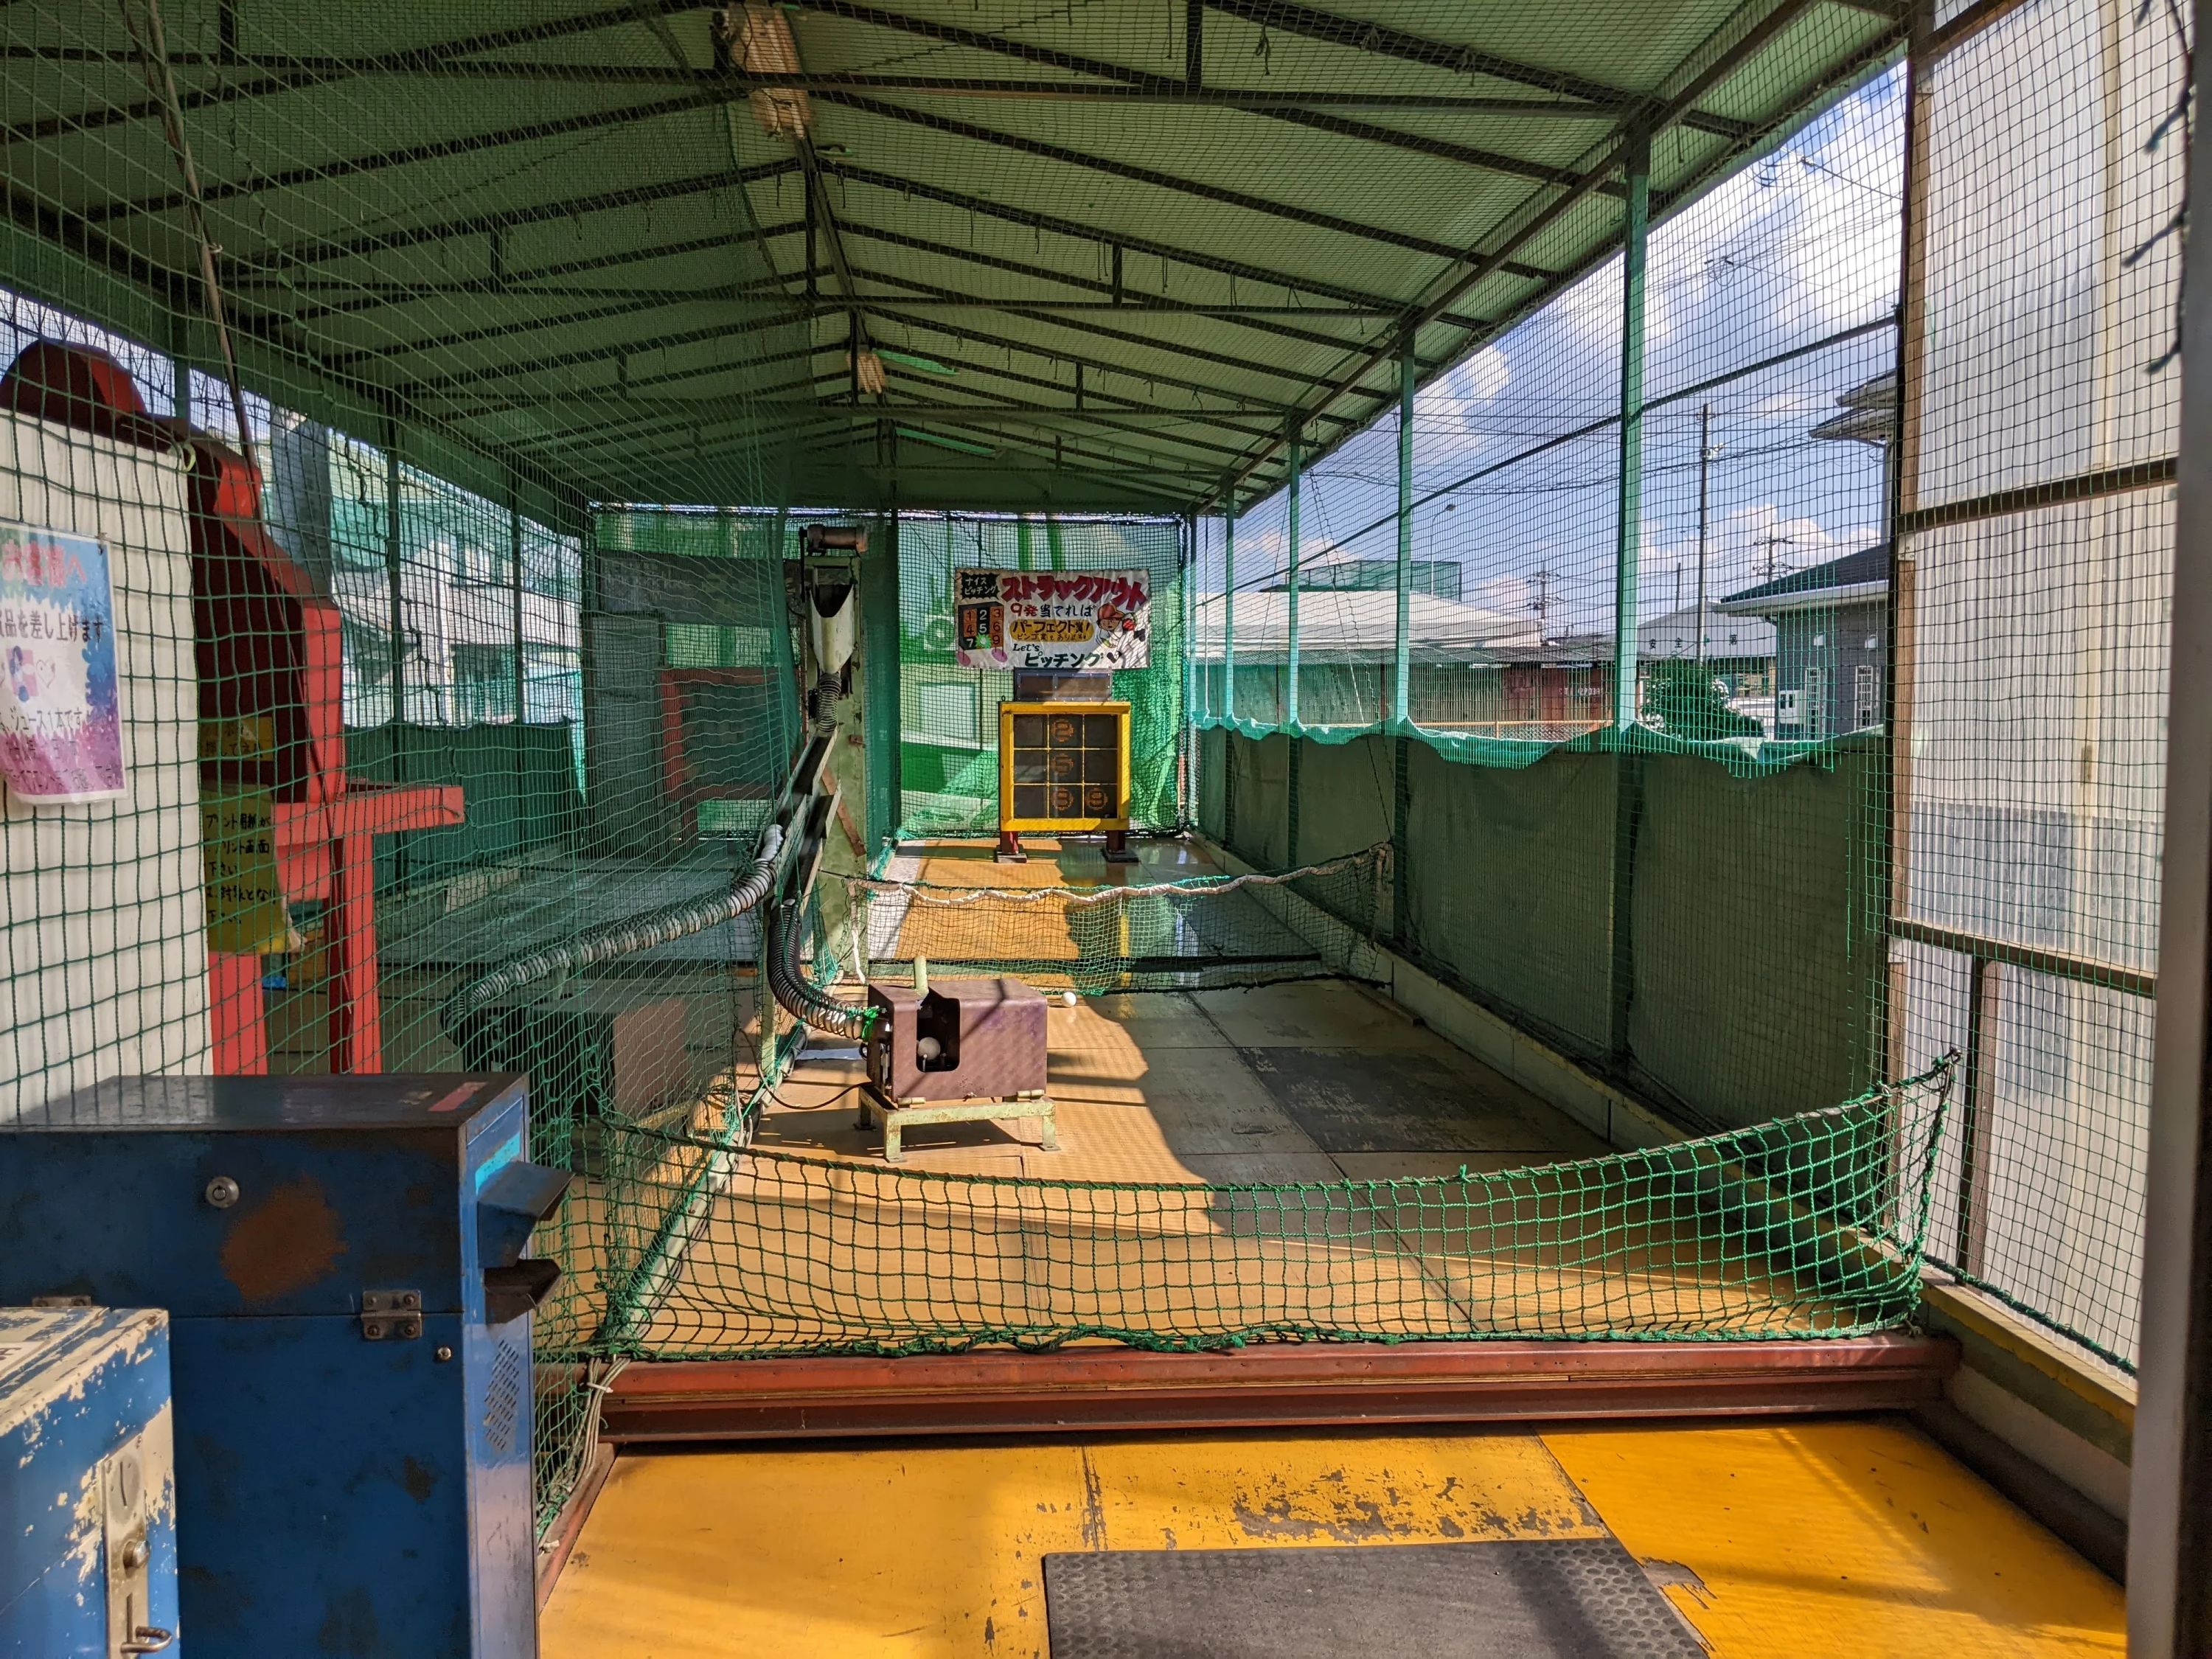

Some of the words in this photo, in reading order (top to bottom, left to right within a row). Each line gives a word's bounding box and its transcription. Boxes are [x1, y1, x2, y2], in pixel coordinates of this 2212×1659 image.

[965, 577, 987, 586] ナイス
[964, 585, 998, 595] ピッチング
[1001, 575, 1147, 611] ストラックアウト
[967, 611, 973, 622] 1
[979, 610, 987, 621] 2
[993, 608, 1001, 618] 3
[0, 608, 104, 643] 品を差し上げます
[967, 625, 974, 635] 4
[979, 623, 987, 633] 5
[992, 622, 1001, 632] 6
[967, 639, 974, 648] 7
[992, 635, 1001, 645] 9
[1012, 643, 1040, 653] Let's
[1025, 651, 1105, 667] ピッチング
